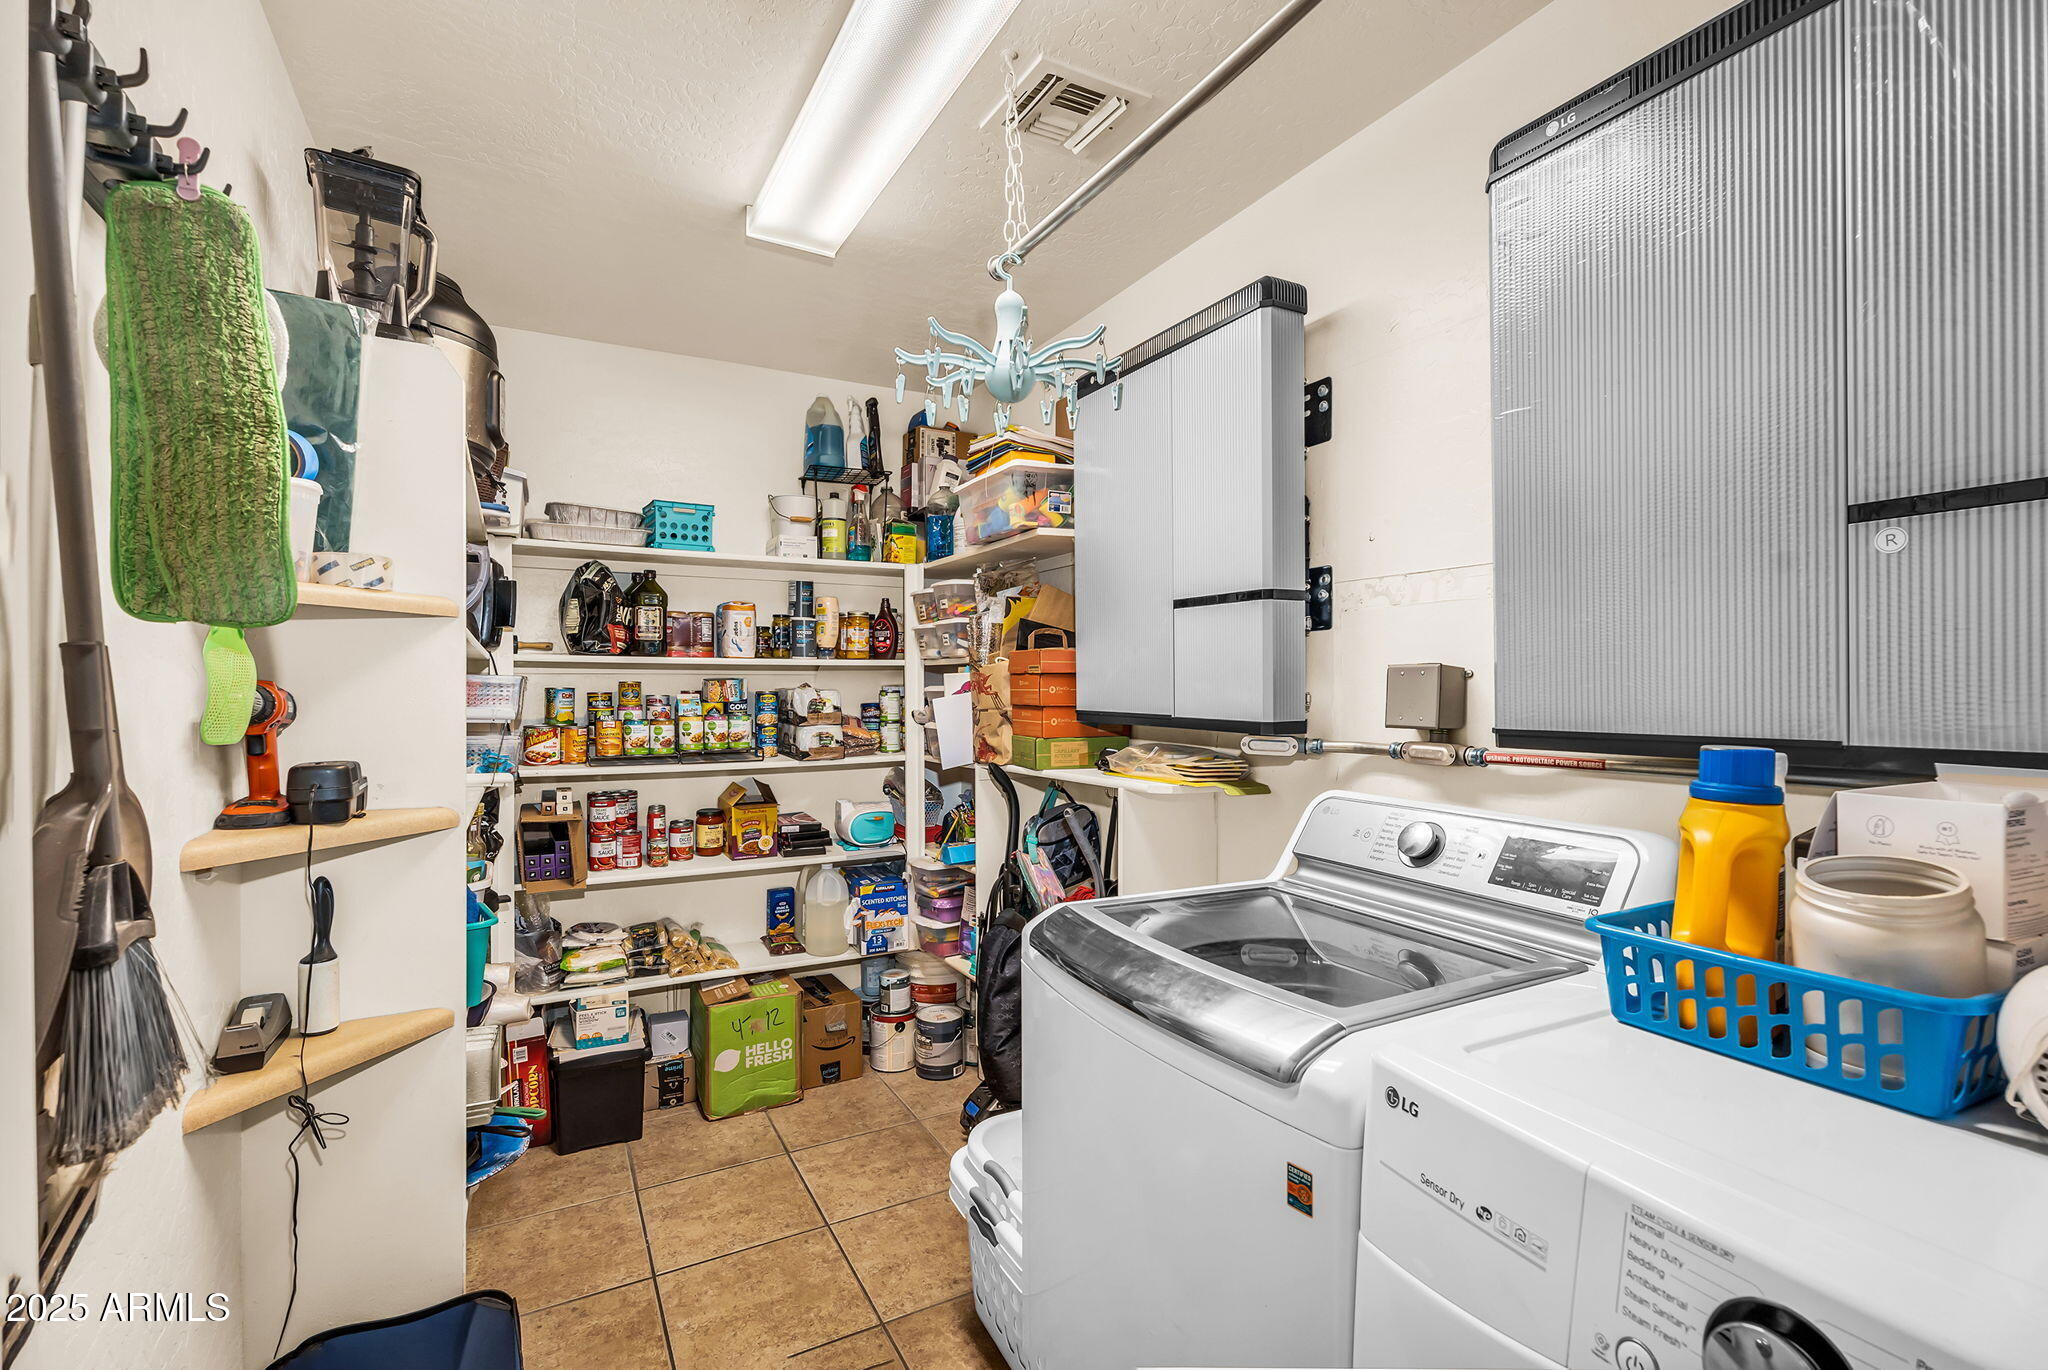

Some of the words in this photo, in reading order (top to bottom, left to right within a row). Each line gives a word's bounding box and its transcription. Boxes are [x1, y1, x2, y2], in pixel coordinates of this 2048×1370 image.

[1560, 112, 1576, 128] LG
[1512, 756, 1555, 766] PHOTOVOLTAIC
[872, 936, 882, 944] 13
[745, 1037, 793, 1057] HELLO
[745, 1048, 793, 1069] FRESH
[822, 1066, 839, 1076] prime
[528, 1064, 540, 1109] OPCORN
[1402, 1096, 1420, 1118] LG
[1288, 1165, 1312, 1182] CERTIFIED
[1420, 1172, 1448, 1197] Sensor
[1450, 1192, 1465, 1211] Dry
[1630, 1214, 1664, 1240] Normal
[1630, 1232, 1658, 1256] Heavy
[1660, 1248, 1684, 1268] Duty
[1627, 1249, 1666, 1280] Bedding
[1624, 1286, 1651, 1310] Steam
[1626, 1268, 1688, 1312] Antibacterial
[1622, 1305, 1652, 1332] Steam
